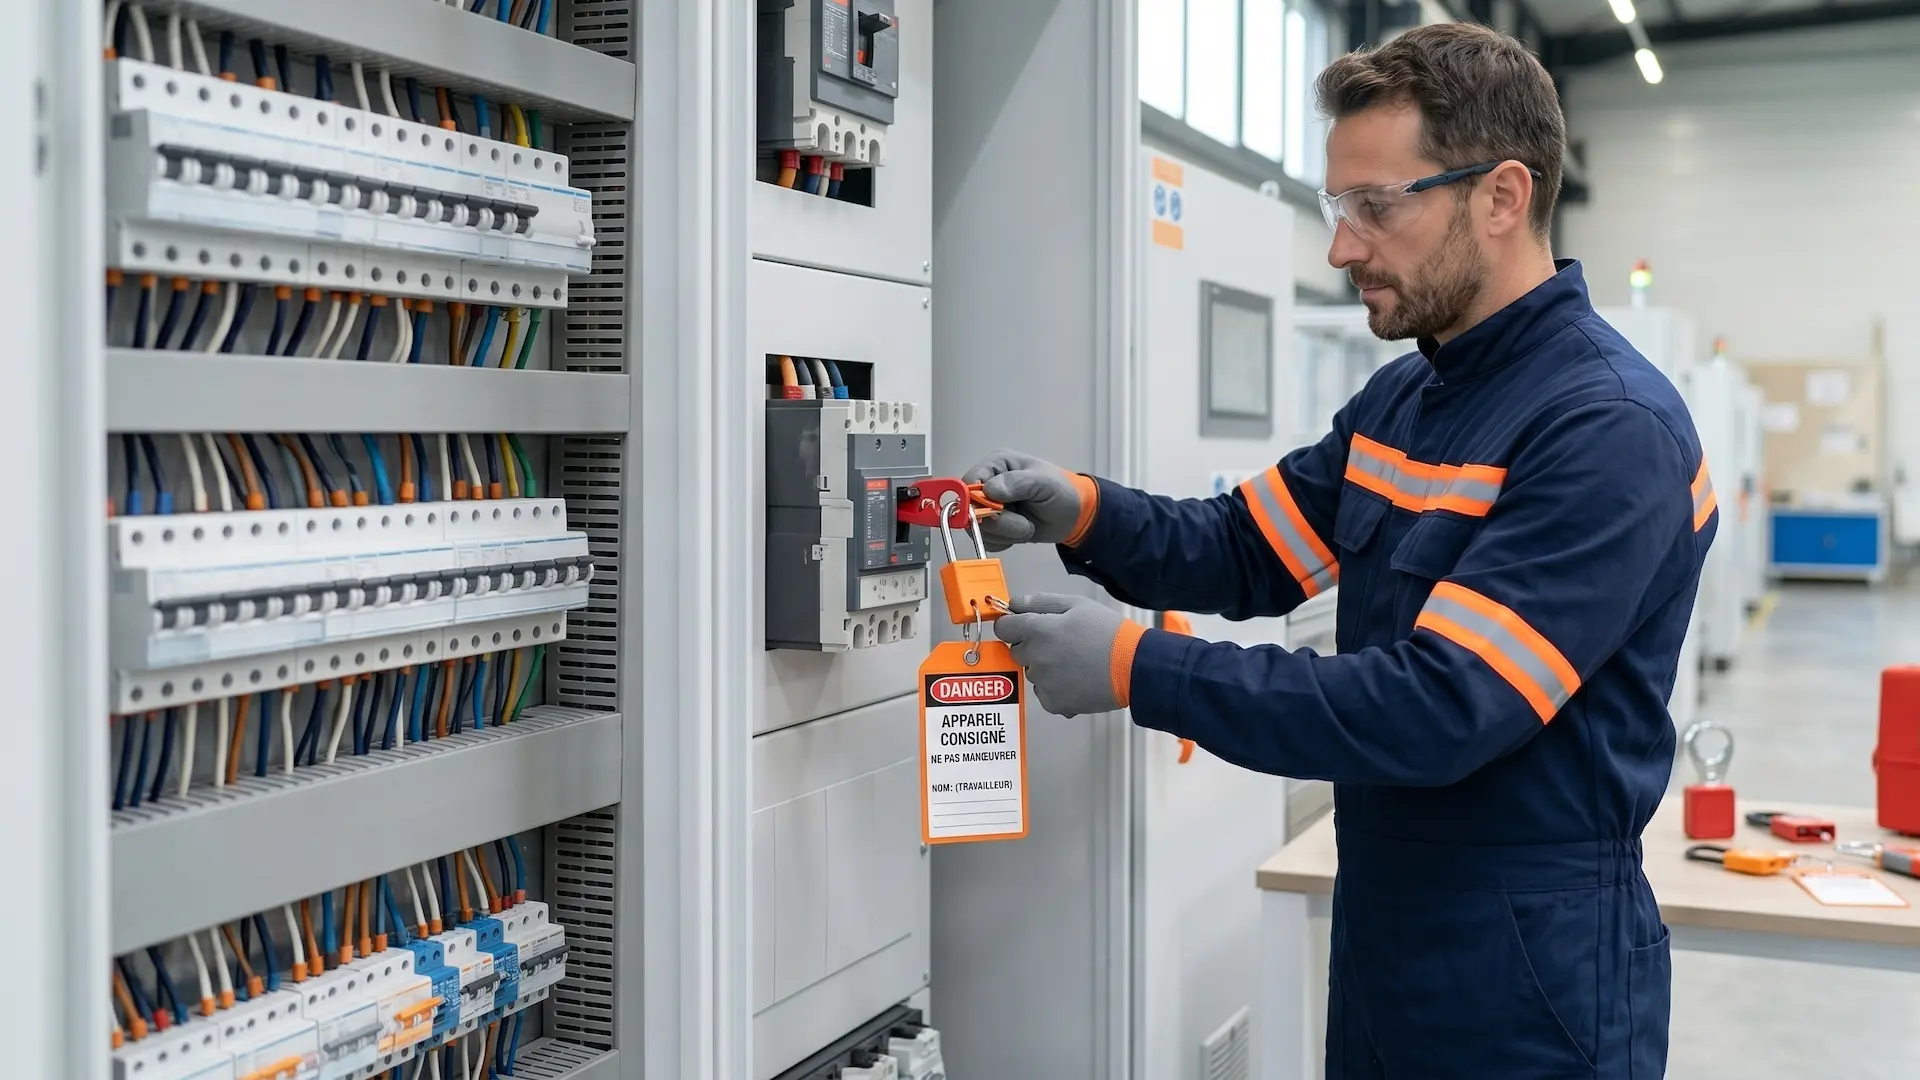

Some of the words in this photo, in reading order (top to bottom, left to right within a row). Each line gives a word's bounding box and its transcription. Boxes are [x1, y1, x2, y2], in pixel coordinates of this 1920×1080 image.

[940, 681, 1004, 698] DANGER
[942, 713, 1004, 728] APPAREIL
[941, 728, 1006, 746] CONSIGNÉ
[931, 754, 942, 764] NE
[945, 753, 960, 763] PAS
[963, 751, 1017, 762] MANŒUVRER
[932, 783, 953, 792] NOM:
[955, 780, 1013, 793] (TRAVAILLEUR)
